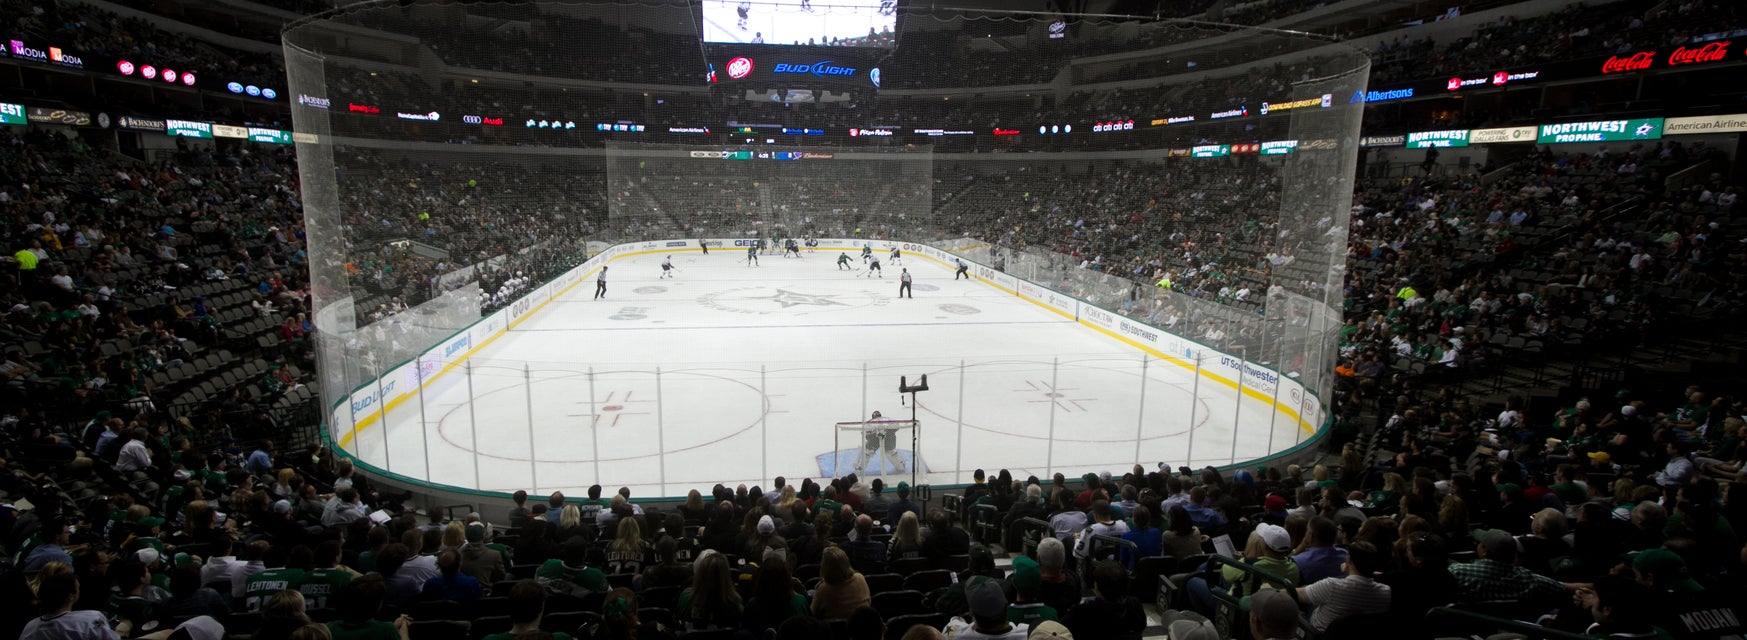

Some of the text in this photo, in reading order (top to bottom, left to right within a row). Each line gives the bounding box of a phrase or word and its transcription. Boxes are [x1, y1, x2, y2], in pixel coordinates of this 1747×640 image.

[15, 46, 47, 59] MODIA
[54, 53, 83, 65] MODIA
[773, 63, 811, 73] BUD
[816, 65, 857, 77] LIGHT
[1366, 88, 1414, 102] Albertsons
[167, 120, 210, 132] NORTHWEST
[483, 117, 503, 125] Audi
[1667, 119, 1747, 131] American Airline
[248, 128, 281, 138] NORTHWEST
[1543, 120, 1628, 137] NORTHWEST
[1409, 130, 1469, 143] NORTHWEST
[1555, 132, 1601, 142] PROPANE
[1192, 145, 1221, 153] NORTHWEST
[1261, 140, 1298, 150] NORTHWEST
[1130, 325, 1158, 343] SOUTHWEST
[1221, 356, 1279, 385] UT Southwester
[247, 581, 289, 593] LEHTONEN
[1679, 608, 1741, 633] MODAN
